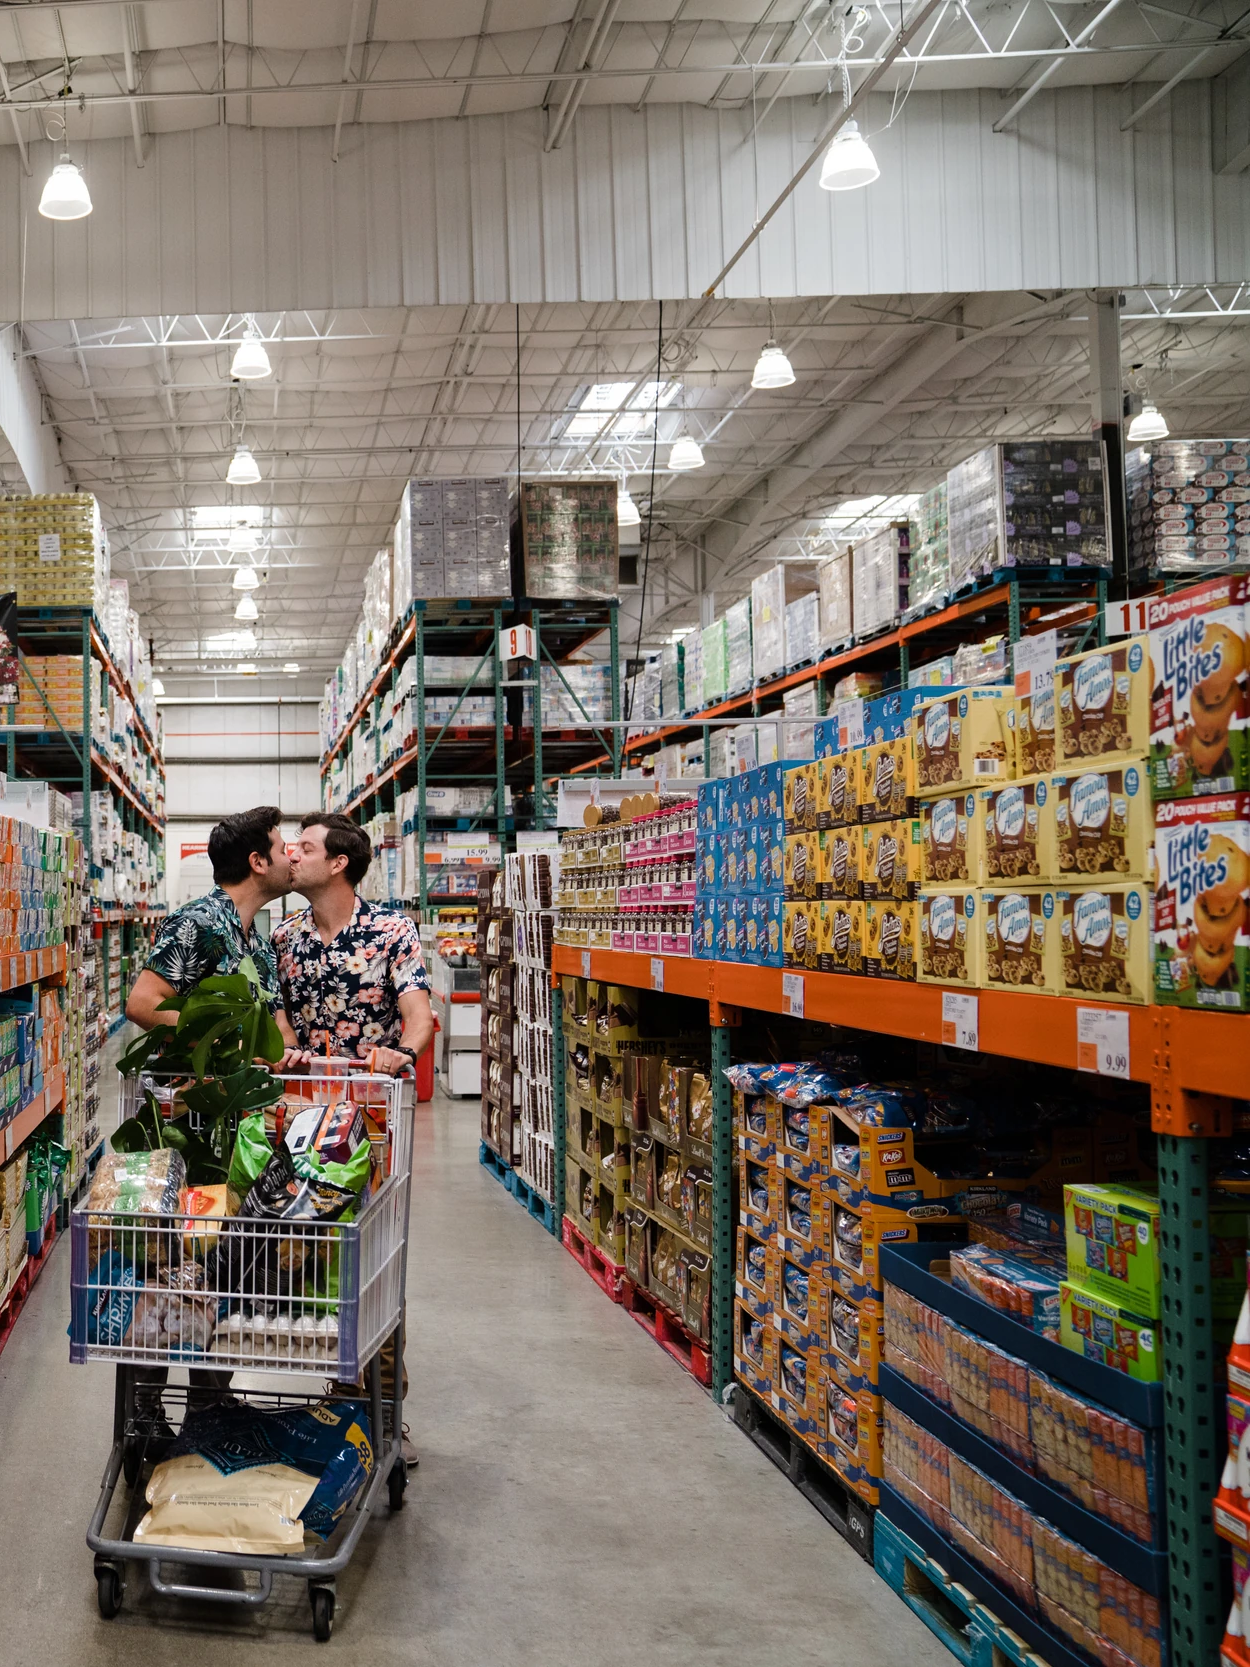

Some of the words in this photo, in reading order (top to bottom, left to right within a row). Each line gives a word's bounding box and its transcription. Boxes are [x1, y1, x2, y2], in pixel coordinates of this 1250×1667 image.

[1120, 601, 1146, 633] 11
[1150, 602, 1169, 624] 20
[1169, 599, 1190, 614] POUCH
[1191, 593, 1211, 608] VALUE
[1211, 586, 1230, 601] PACK
[510, 629, 518, 656] 9
[525, 629, 532, 655] 10
[1163, 615, 1205, 682] Little
[1130, 650, 1141, 662] 42
[1075, 655, 1112, 686] Famous
[1176, 643, 1222, 702] Bites
[960, 699, 967, 711] 42
[1084, 674, 1112, 710] Amos
[926, 702, 949, 726] Famous
[931, 720, 950, 748] Amos
[1037, 786, 1046, 798] 42
[1072, 773, 1109, 804] Famous
[1126, 774, 1138, 787] 42
[932, 799, 956, 824] Famous
[966, 799, 974, 810] 42
[997, 788, 1024, 814] Famous
[1079, 795, 1110, 826] Amos
[1156, 804, 1174, 822] 20
[1174, 804, 1196, 818] POUCH
[1197, 801, 1217, 814] VALUE
[1217, 799, 1236, 812] PACK
[937, 817, 957, 843] Amos
[1002, 807, 1025, 836] Amos
[1168, 824, 1209, 884] Little
[1180, 856, 1227, 906] Bites
[931, 896, 955, 921] Famous
[999, 894, 1029, 922] Famous
[1075, 894, 1110, 922] Famous
[937, 914, 956, 940] Amos
[1005, 912, 1031, 942] Amos
[1083, 913, 1111, 944] Amos
[617, 1040, 666, 1055] HERSHEY'S
[962, 1031, 976, 1046] 7.89
[1106, 1054, 1127, 1073] 9.99
[878, 1132, 904, 1141] SNICKERS
[1075, 1195, 1100, 1211] VARIETY
[1101, 1202, 1117, 1215] PACK
[1024, 1213, 1037, 1225] Variety
[1037, 1217, 1048, 1227] Pack
[1137, 1225, 1148, 1237] 40
[881, 1229, 908, 1239] SNICKERS
[1074, 1292, 1099, 1310] VARIETY
[1101, 1305, 1118, 1319] PACK
[357, 1440, 370, 1464] 38
